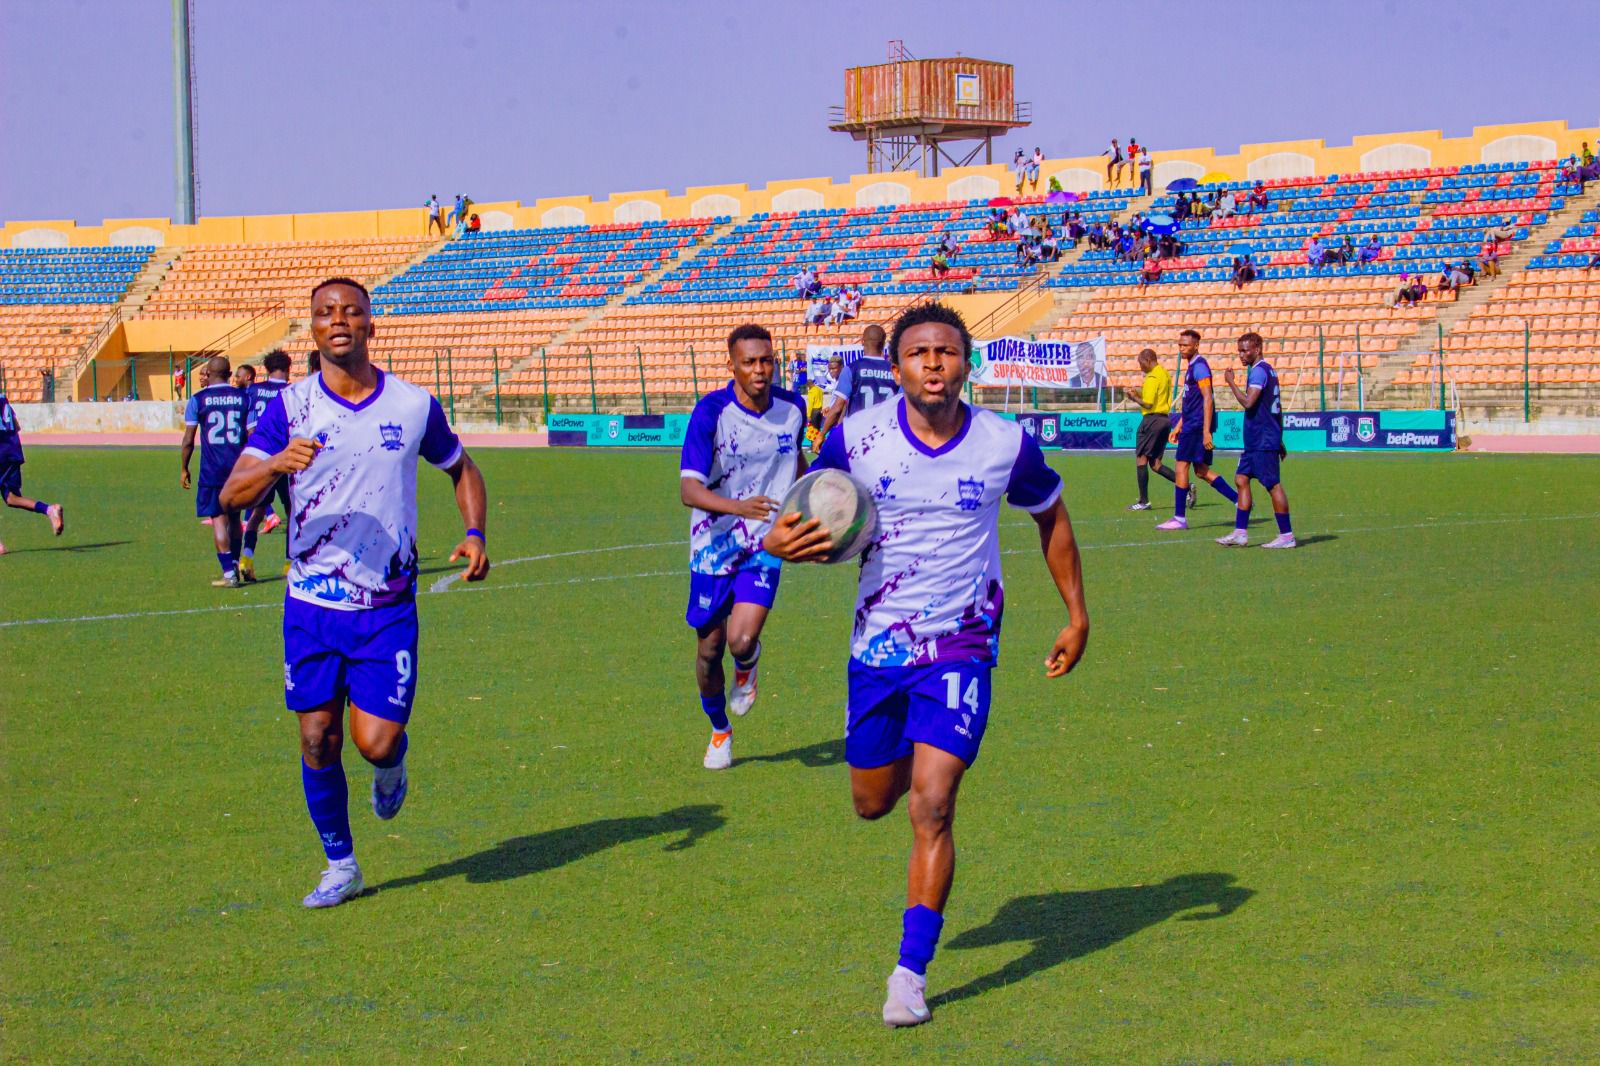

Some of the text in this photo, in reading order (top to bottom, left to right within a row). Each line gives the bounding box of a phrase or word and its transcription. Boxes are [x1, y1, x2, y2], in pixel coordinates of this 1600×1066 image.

[1046, 367, 1069, 382] CLUB
[205, 395, 243, 406] BAKAM
[207, 410, 241, 444] 25
[552, 418, 585, 428] betPawa
[1063, 417, 1107, 428] betPawa
[627, 432, 661, 442] betPawa
[1386, 432, 1440, 446] betPawa
[395, 649, 412, 685] 9
[941, 671, 979, 715] 14
